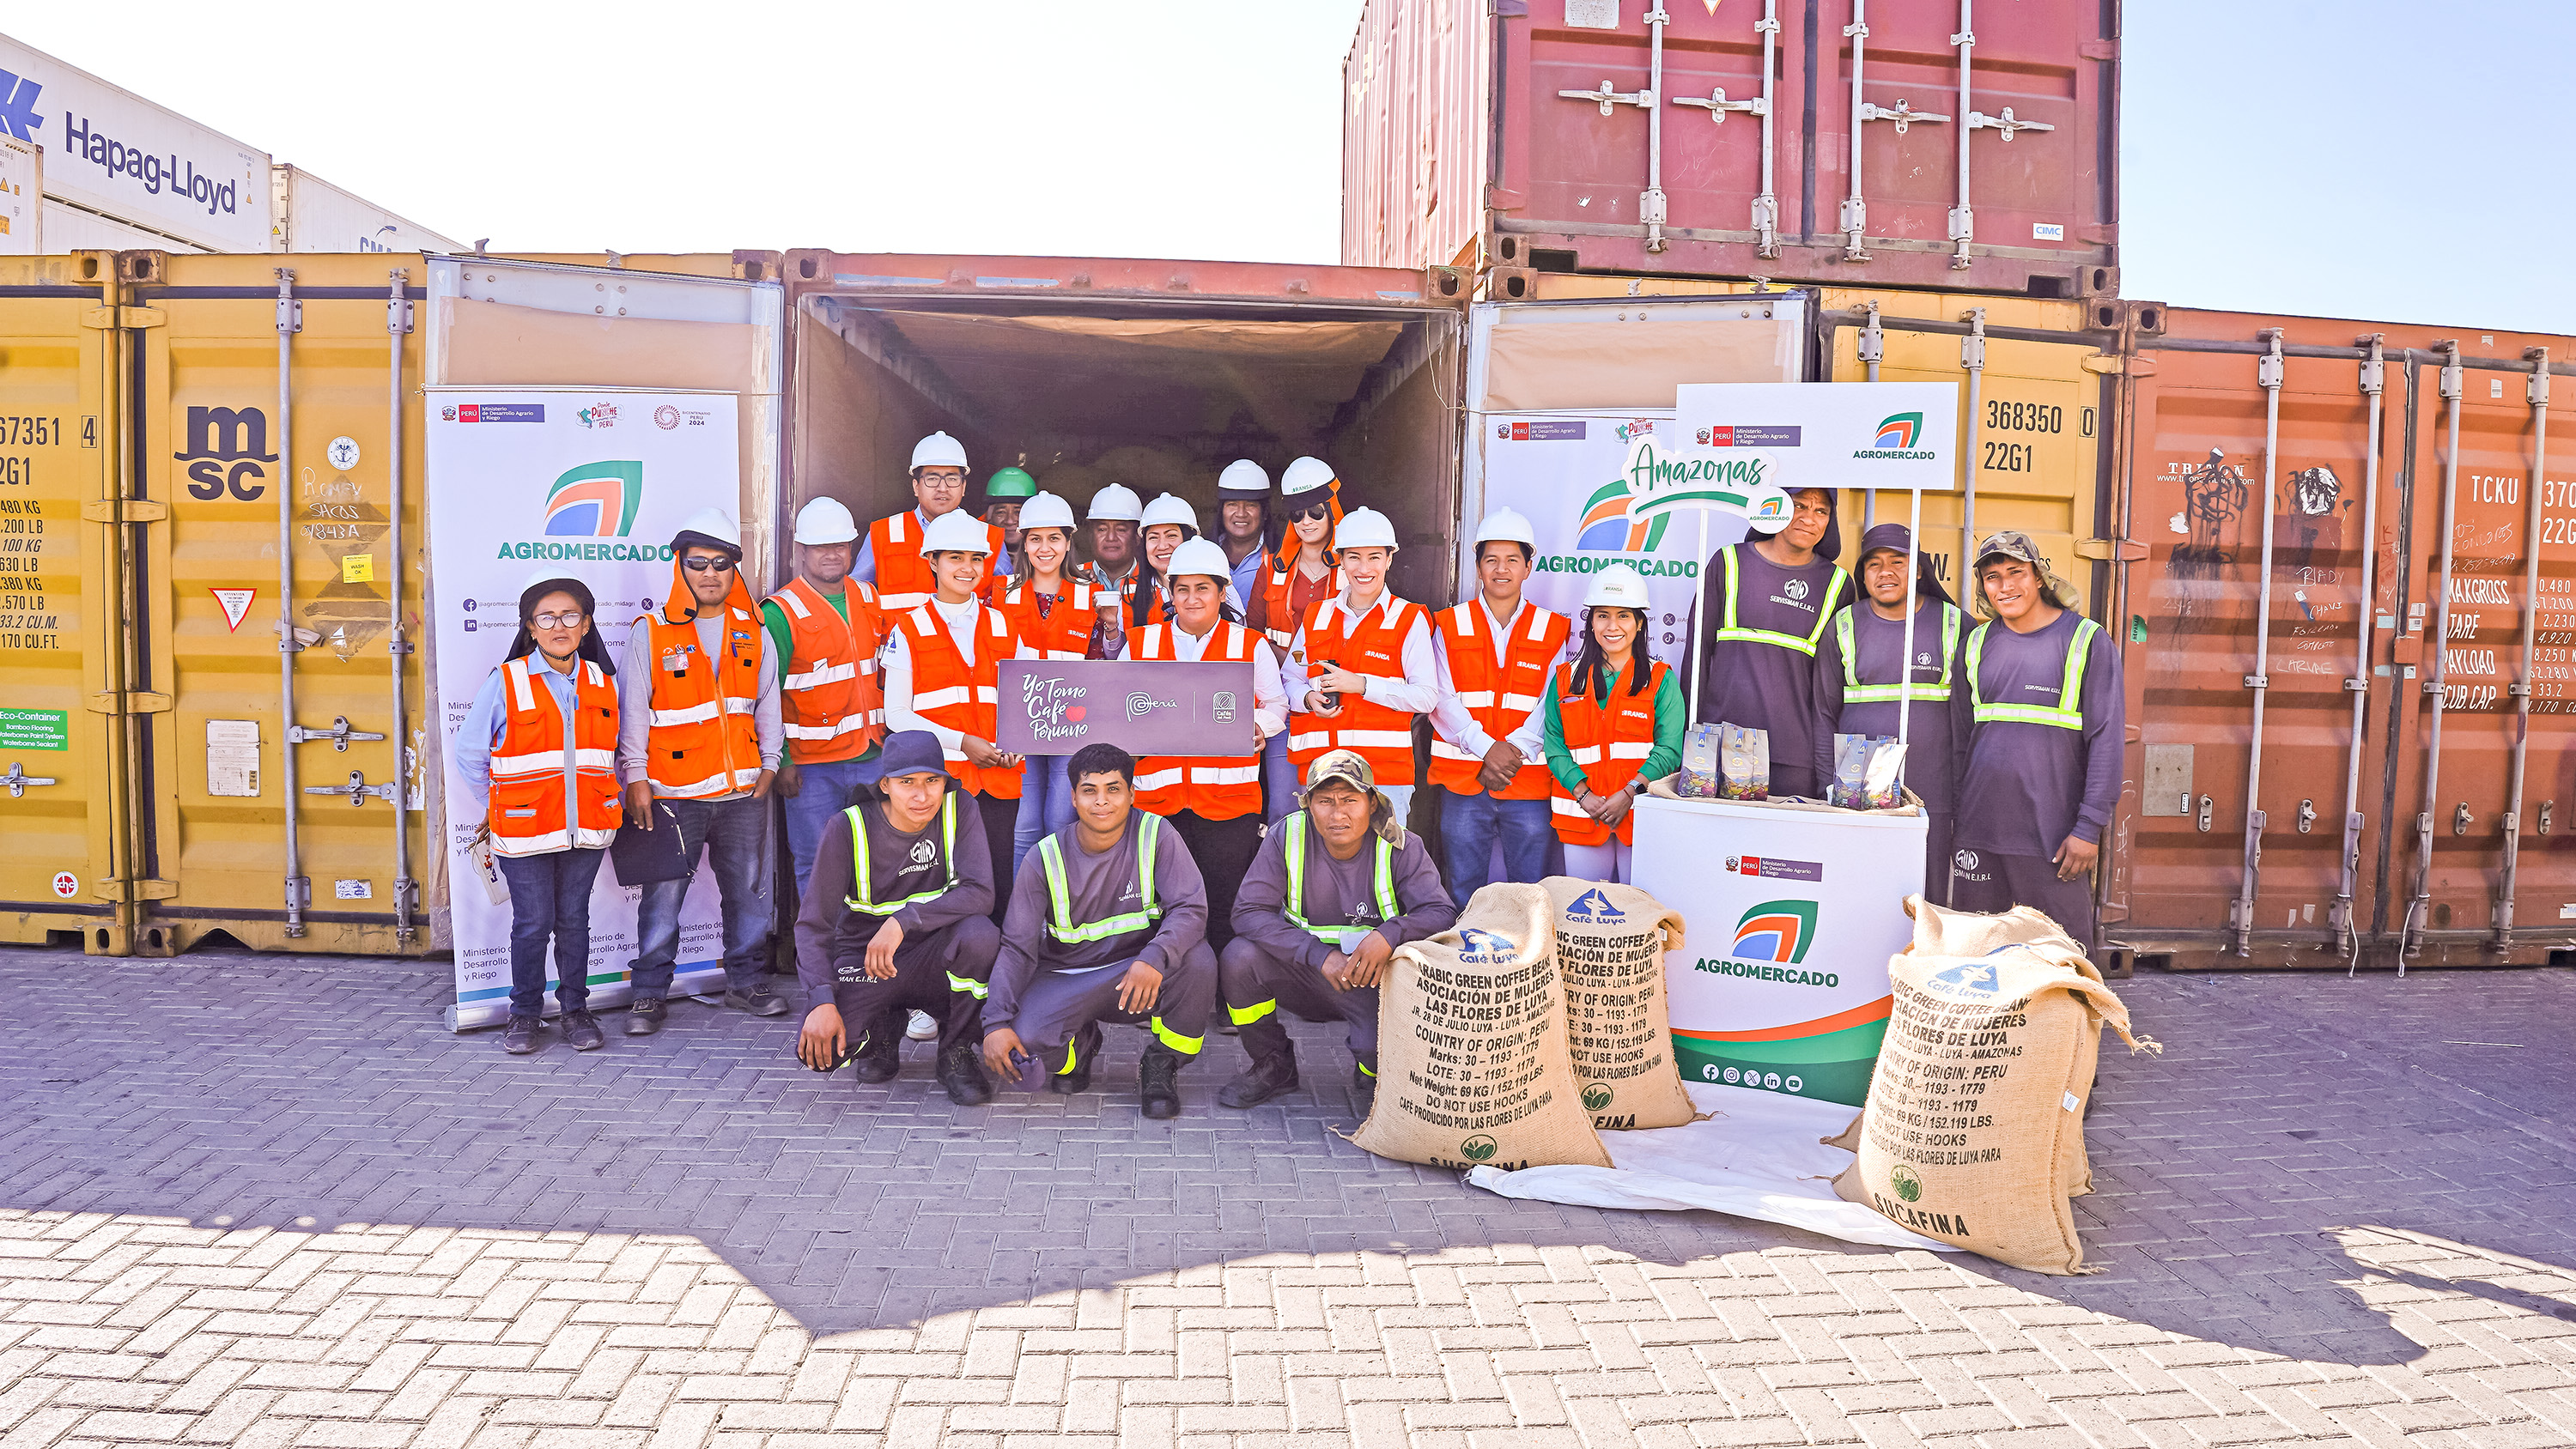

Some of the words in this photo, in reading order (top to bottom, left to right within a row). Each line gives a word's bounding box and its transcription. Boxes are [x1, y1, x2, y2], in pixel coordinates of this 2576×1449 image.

[65, 111, 236, 215] Hapag-Lloyd
[2036, 227, 2061, 235] CIMC
[598, 420, 613, 428] PERÚ
[1987, 400, 2063, 433] 368350
[2082, 408, 2094, 436] 0
[83, 418, 95, 446] 4
[1852, 450, 1935, 460] AGROMERCADO
[1984, 442, 2032, 472] 22G1
[1631, 443, 1767, 491] Amazonas
[2471, 476, 2518, 505] TCKU
[24, 500, 41, 514] KG
[28, 519, 44, 534] LB
[3, 538, 22, 552] 100
[25, 539, 42, 553] KG
[497, 542, 674, 563] AGROMERCADO
[23, 558, 38, 573] LB
[2449, 578, 2510, 605] MAXGROSS
[1770, 594, 1800, 608] SERVISMAN
[27, 615, 58, 629] CU.M.
[25, 634, 59, 650] CU.FT.
[1370, 651, 1390, 661] RANSA
[1522, 661, 1541, 671] RANSA
[1022, 673, 1046, 703] Yo
[1045, 677, 1087, 700] Tomo
[0, 712, 60, 721] Eco-Container
[1027, 694, 1071, 724] Café
[1627, 711, 1648, 720] RANSA
[1029, 718, 1089, 743] Peruano
[898, 864, 929, 877] SERVISMAN
[1565, 913, 1592, 924] Café
[1596, 916, 1626, 925] Luya
[1572, 934, 1606, 949] GREEN
[1608, 933, 1645, 949] COFFEE
[462, 946, 506, 958] Ministerio
[1459, 953, 1489, 964] Café
[1492, 954, 1520, 965] Luya
[464, 957, 508, 970] Desarrollo
[1567, 960, 1613, 977] FLORES
[1633, 958, 1653, 975] LUYA
[464, 973, 471, 982] y
[471, 970, 497, 984] Riego
[1418, 961, 1453, 985] ARABIC
[1455, 972, 1492, 990] GREEN
[1494, 966, 1530, 988] COFFEE
[1532, 955, 1551, 979] BEANS
[1694, 957, 1839, 989] AGROMERCADO
[1417, 977, 1491, 1005] ASOCIACIÓN
[1494, 991, 1510, 1004] DE
[1514, 969, 1554, 1000] MUJERES
[1425, 997, 1448, 1016] LAS
[1452, 1004, 1502, 1021] FLORES
[1505, 1003, 1521, 1018] DE
[1524, 989, 1548, 1011] LUYA
[1412, 1004, 1422, 1019] JR.
[1423, 1010, 1431, 1022] 28
[1433, 1015, 1443, 1027] DE
[1445, 1019, 1469, 1032] JULIO
[1471, 1022, 1493, 1033] LUYA
[1415, 1023, 1465, 1050] COUNTRY
[1467, 1039, 1483, 1052] OF
[1485, 1032, 1527, 1052] ORIGIN:
[1529, 1016, 1551, 1040] PERU
[1970, 1031, 2008, 1046] LUYA
[1429, 1046, 1461, 1065] Marks:
[1464, 1055, 1477, 1066] 30
[1489, 1050, 1512, 1065] 1193
[1521, 1039, 1540, 1056] 1779
[1614, 1048, 1644, 1064] HOOKS
[1426, 1062, 1456, 1080] LOTE:
[1459, 1070, 1472, 1082] 30
[1485, 1067, 1507, 1081] 1193
[1516, 1056, 1535, 1073] 1179
[1972, 1064, 2008, 1081] PERU
[1426, 1094, 1441, 1108] DO
[1443, 1101, 1466, 1113] NOT
[1469, 1100, 1491, 1113] USE
[1493, 1088, 1528, 1111] HOOKS
[1925, 1134, 1967, 1146] HOOKS
[1874, 1192, 1971, 1236] SUCAFINA
